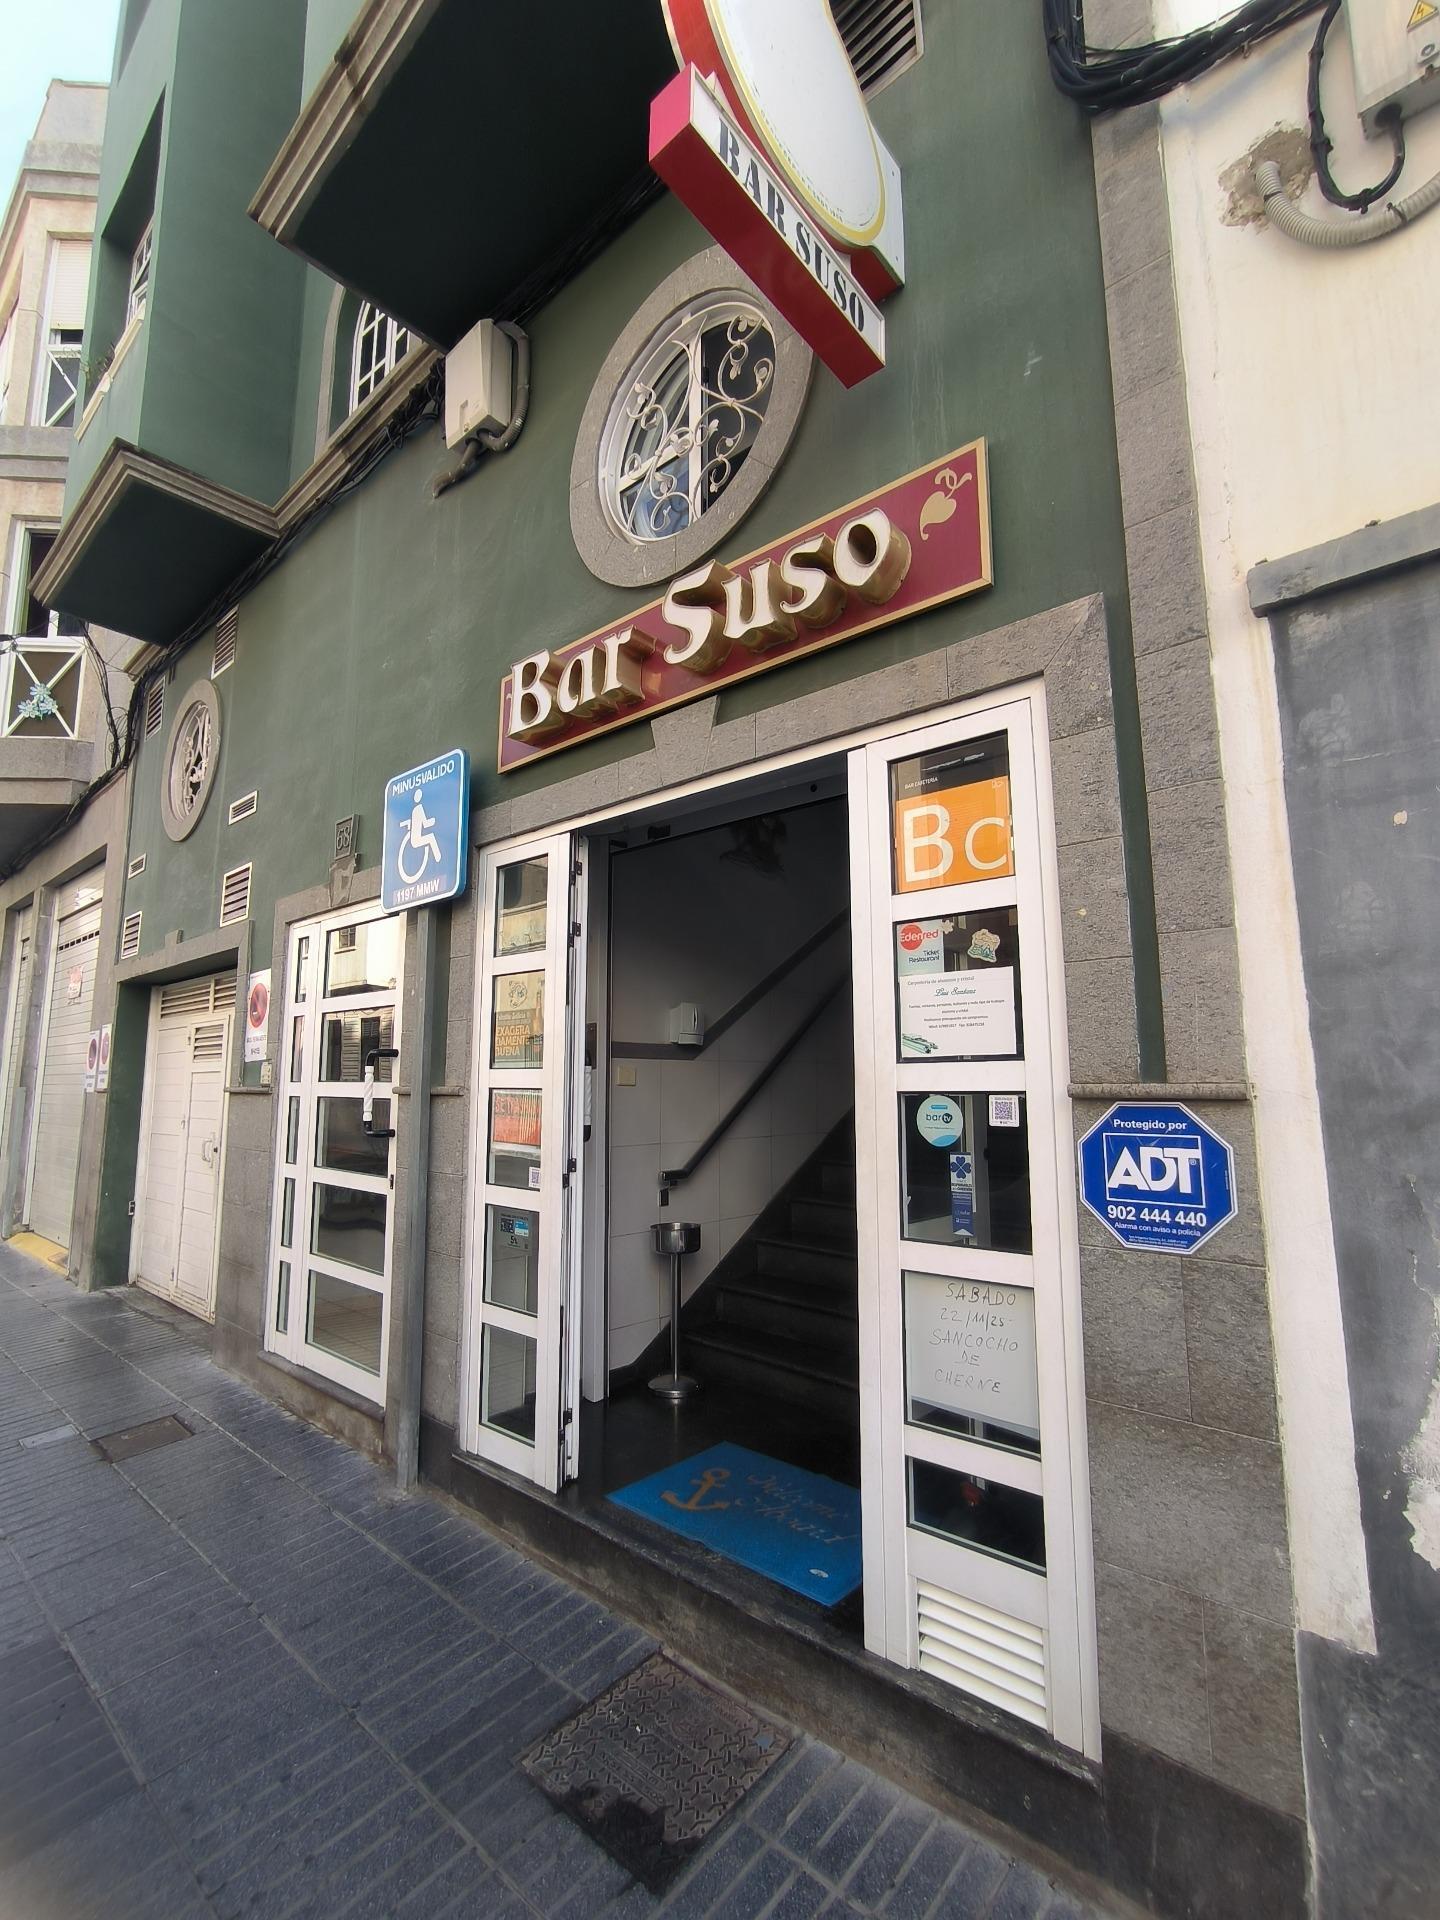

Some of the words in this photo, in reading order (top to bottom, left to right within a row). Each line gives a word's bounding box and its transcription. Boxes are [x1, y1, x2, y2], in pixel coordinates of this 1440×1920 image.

[718, 117, 787, 237] BAR
[795, 221, 865, 333] SUSO
[507, 624, 642, 737] Bar
[661, 507, 892, 666] Suso
[336, 825, 350, 850] 68
[396, 886, 415, 904] 1197
[900, 929, 939, 942] Edenred
[908, 955, 940, 963] Restaurant
[923, 949, 940, 957] Ticket
[497, 1024, 531, 1037] EXAGERA
[1113, 1119, 1166, 1131] Protegido
[1168, 1122, 1187, 1132] por
[1107, 1146, 1200, 1193] ADT
[1107, 1205, 1136, 1220] 902
[1139, 1208, 1171, 1224] 444
[1175, 1211, 1207, 1227] 440
[1114, 1222, 1137, 1230] Alarma
[946, 1282, 1016, 1306] SABADO
[929, 1328, 1018, 1352] SANCOCHO
[934, 1368, 1001, 1394] CHERNE
